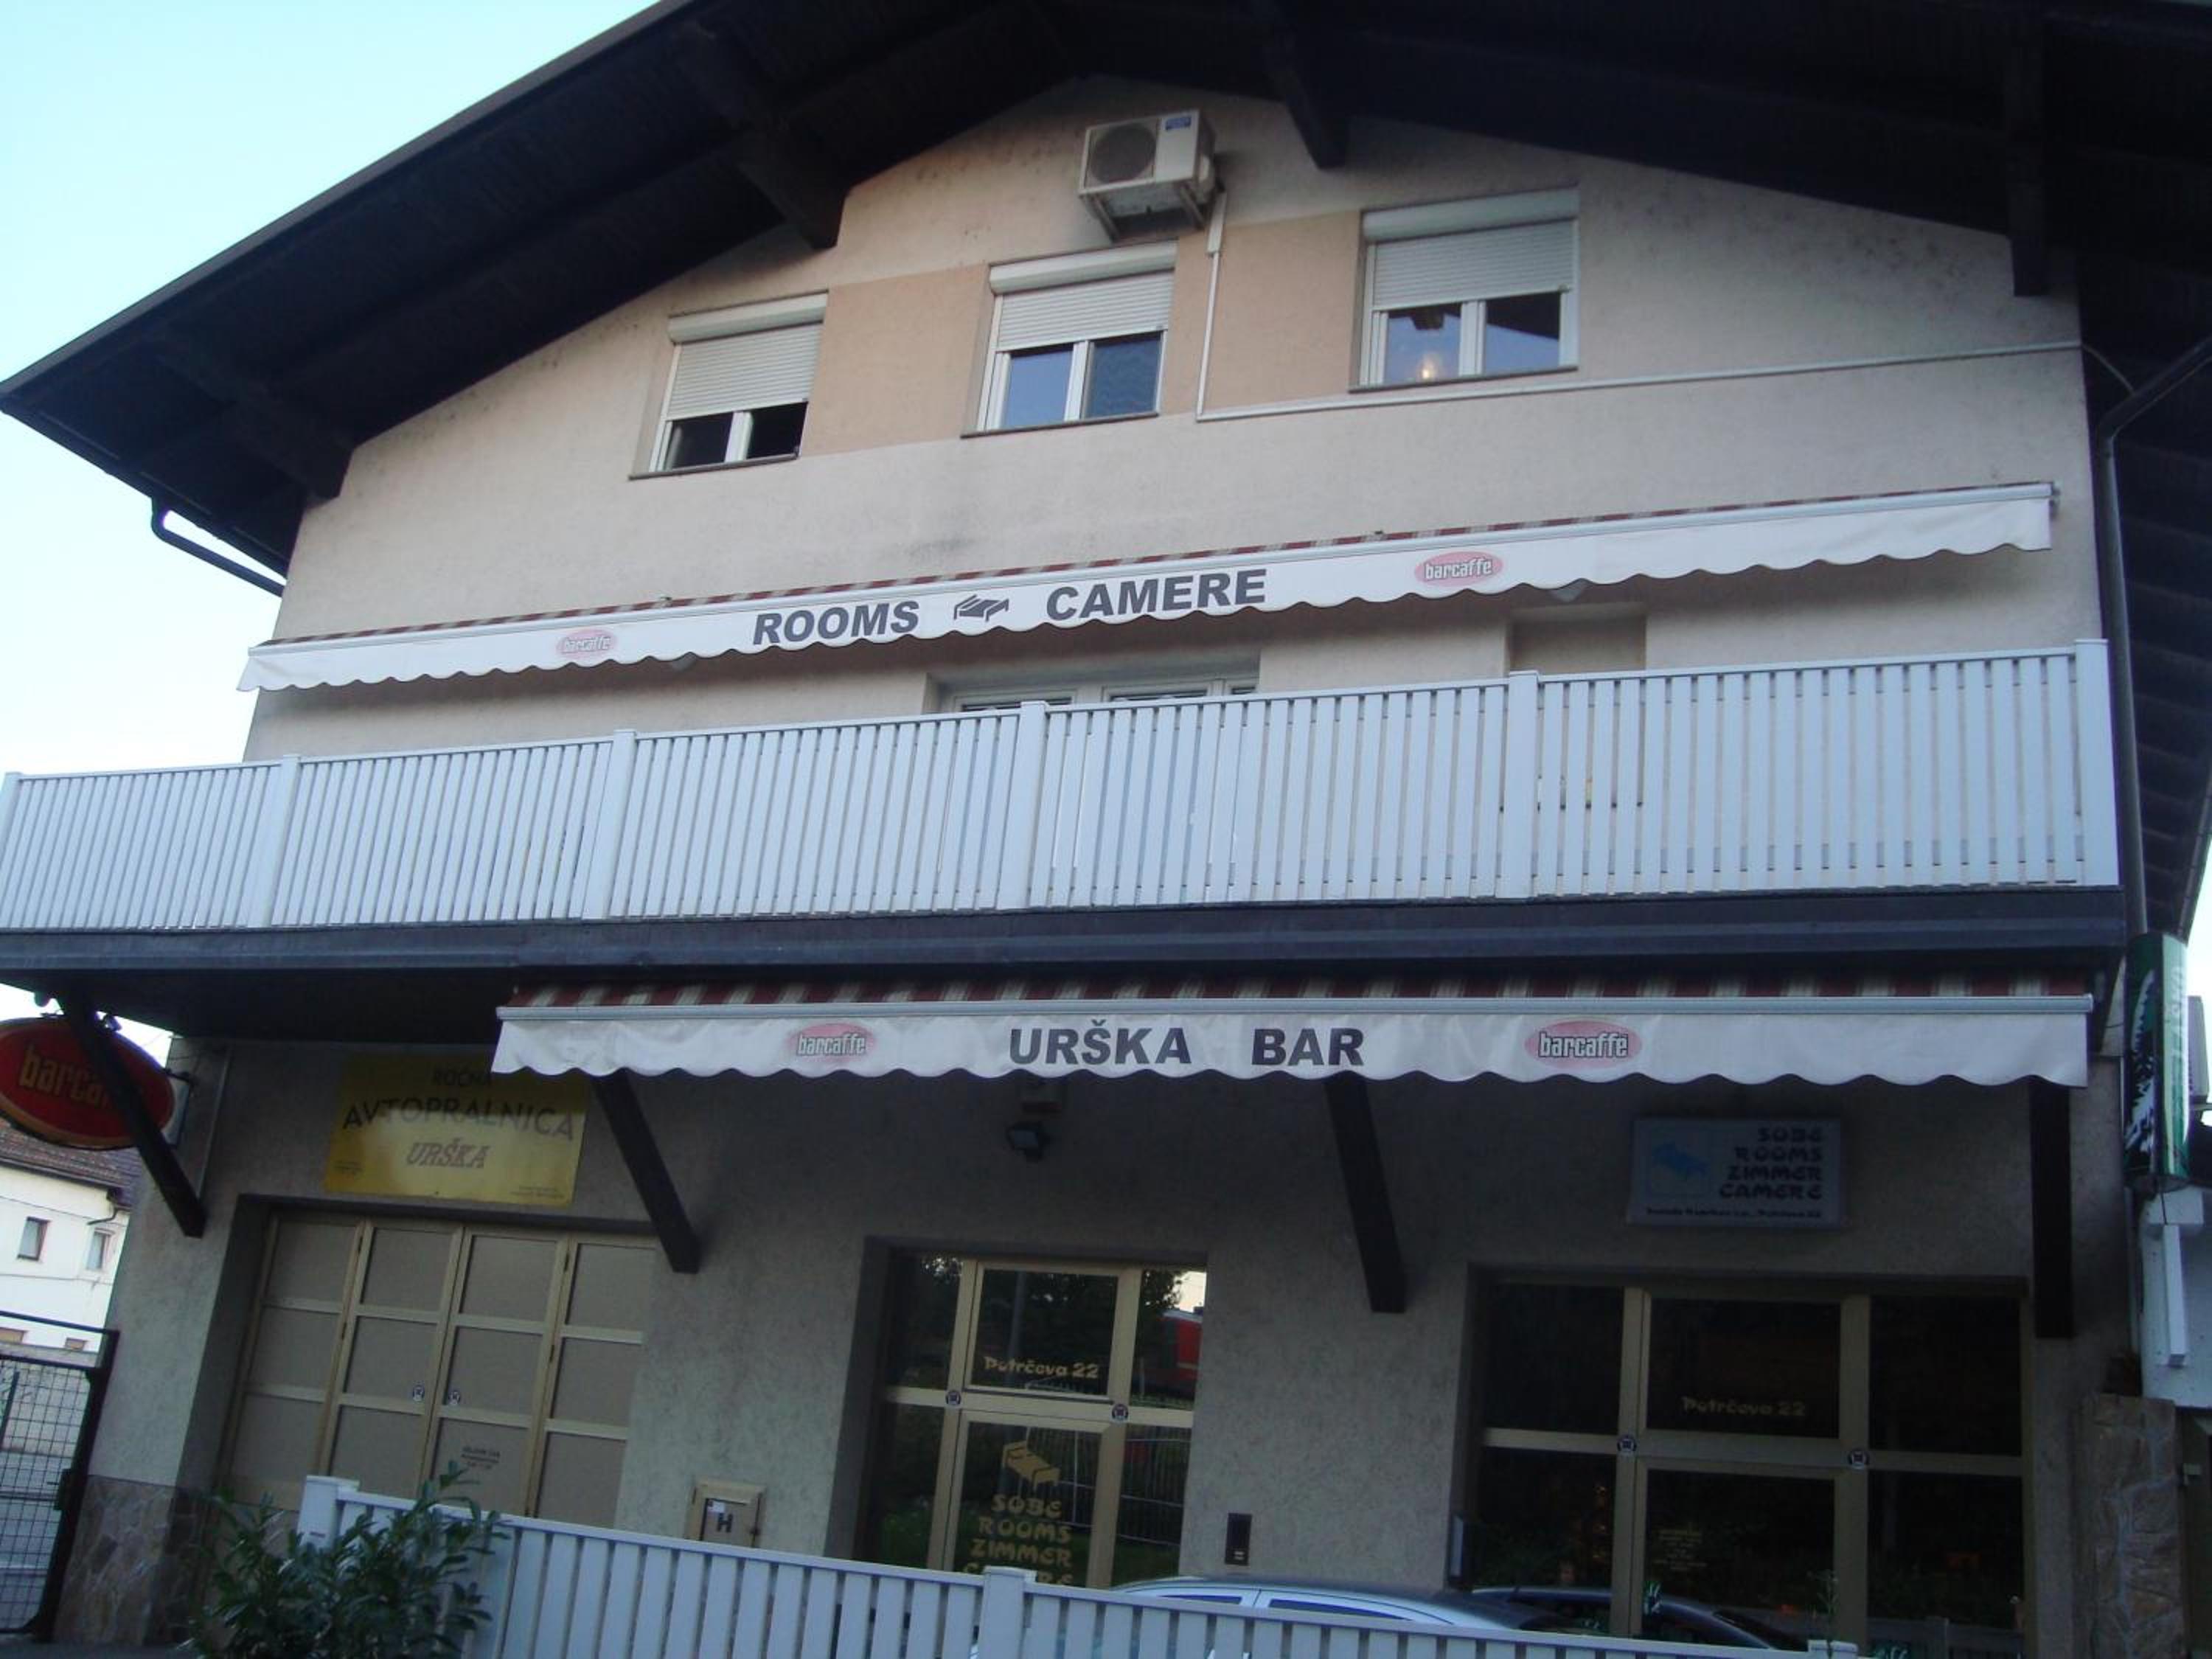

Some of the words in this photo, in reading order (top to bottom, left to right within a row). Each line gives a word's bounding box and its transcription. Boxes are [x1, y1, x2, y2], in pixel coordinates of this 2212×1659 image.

[1424, 556, 1494, 580] barcaffe
[753, 601, 919, 645] ROOMS
[1046, 568, 1267, 621] CAMERE
[796, 1032, 867, 1057] barcaffe
[1009, 1020, 1192, 1065] URŠKA
[1252, 1028, 1364, 1066] BAR
[1538, 1031, 1628, 1059] barcaffe
[342, 1097, 574, 1141] AVTOPRALNICA
[406, 1138, 491, 1169] URŠKA
[1734, 1146, 1822, 1162] ROOMS
[1727, 1165, 1822, 1181] ZIMMER
[1719, 1183, 1822, 1200] CAMERE
[1072, 1362, 1098, 1379] 22
[1778, 1401, 1805, 1416] 22
[991, 1494, 1062, 1519] SOBE
[717, 1512, 733, 1532] H
[978, 1516, 1072, 1543] ROOMS
[970, 1539, 1072, 1566] ZIMMER
